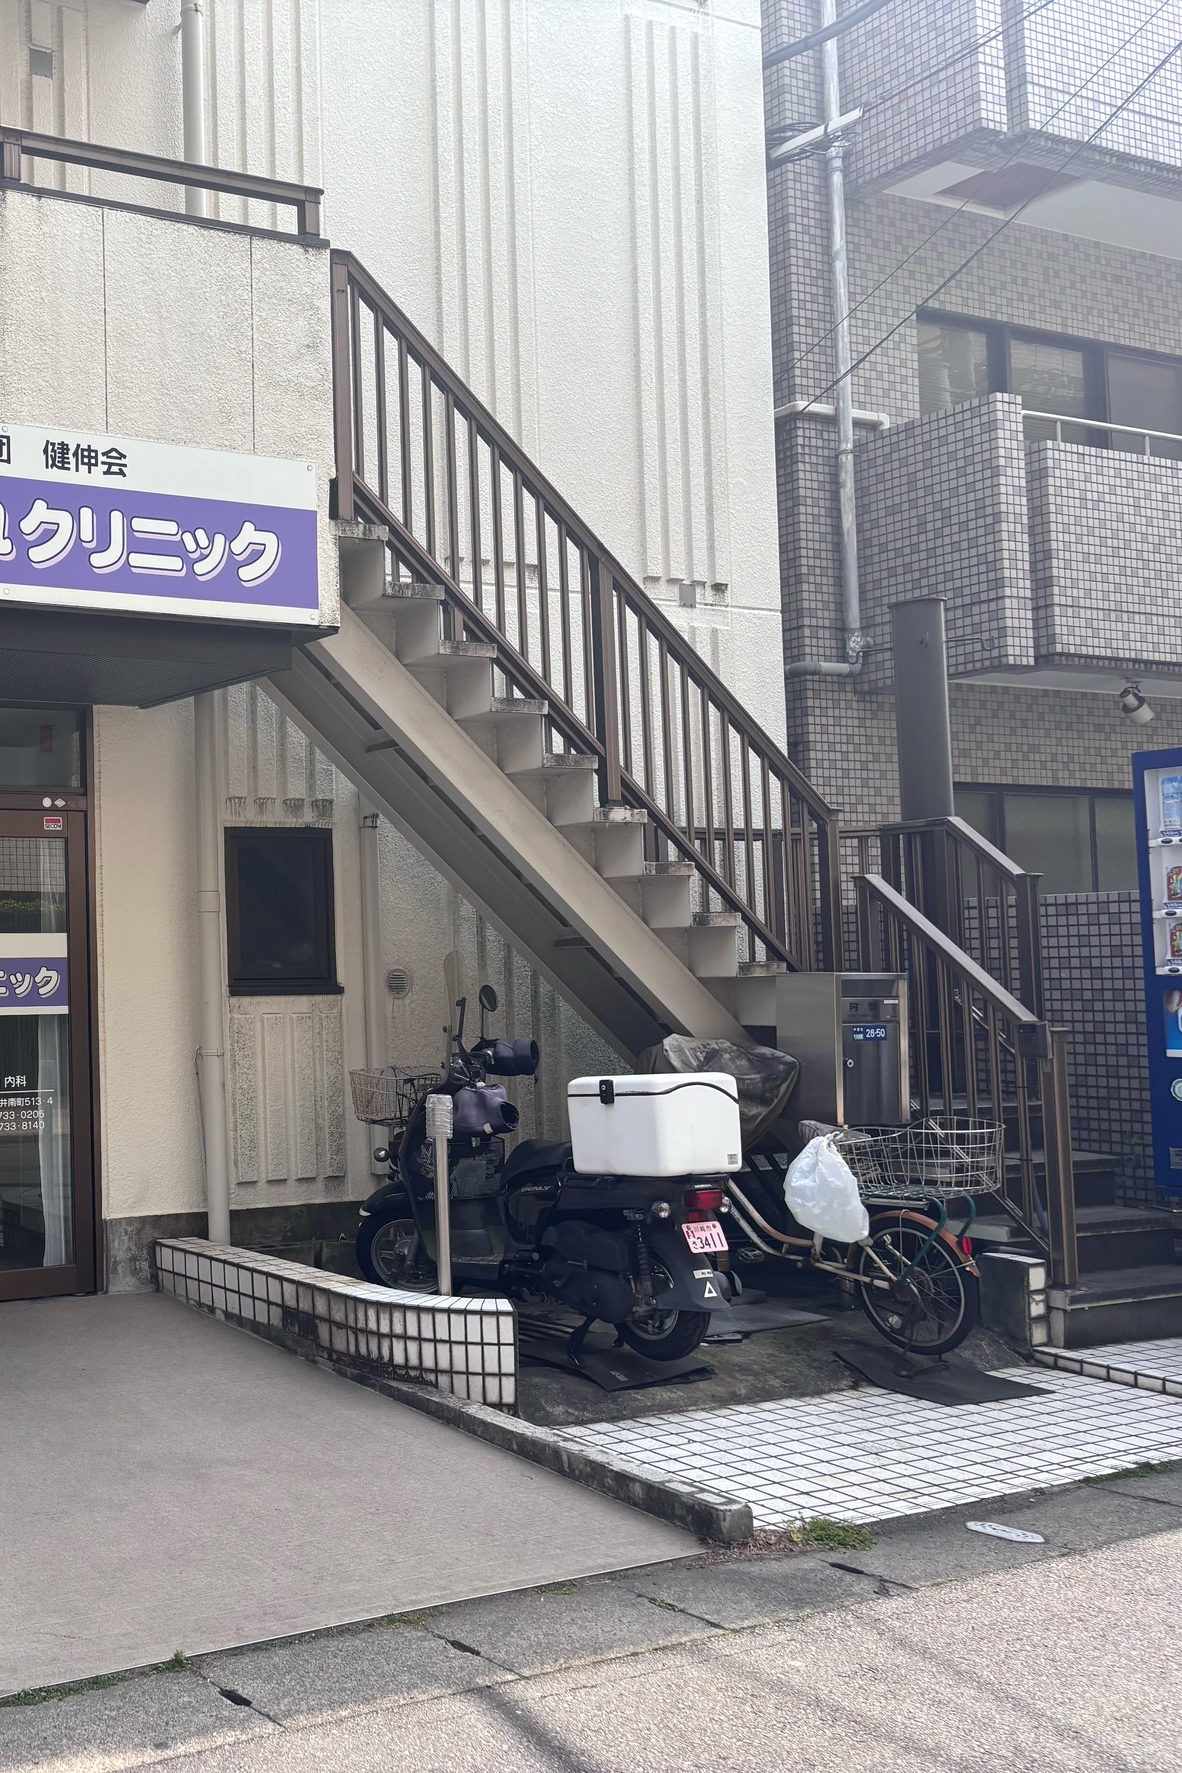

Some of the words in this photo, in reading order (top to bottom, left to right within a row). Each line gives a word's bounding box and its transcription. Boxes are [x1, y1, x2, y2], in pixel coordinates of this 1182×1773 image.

[42, 439, 129, 478] 健伸会
[4, 1075, 27, 1088] 内科
[697, 1232, 724, 1249] 3411
